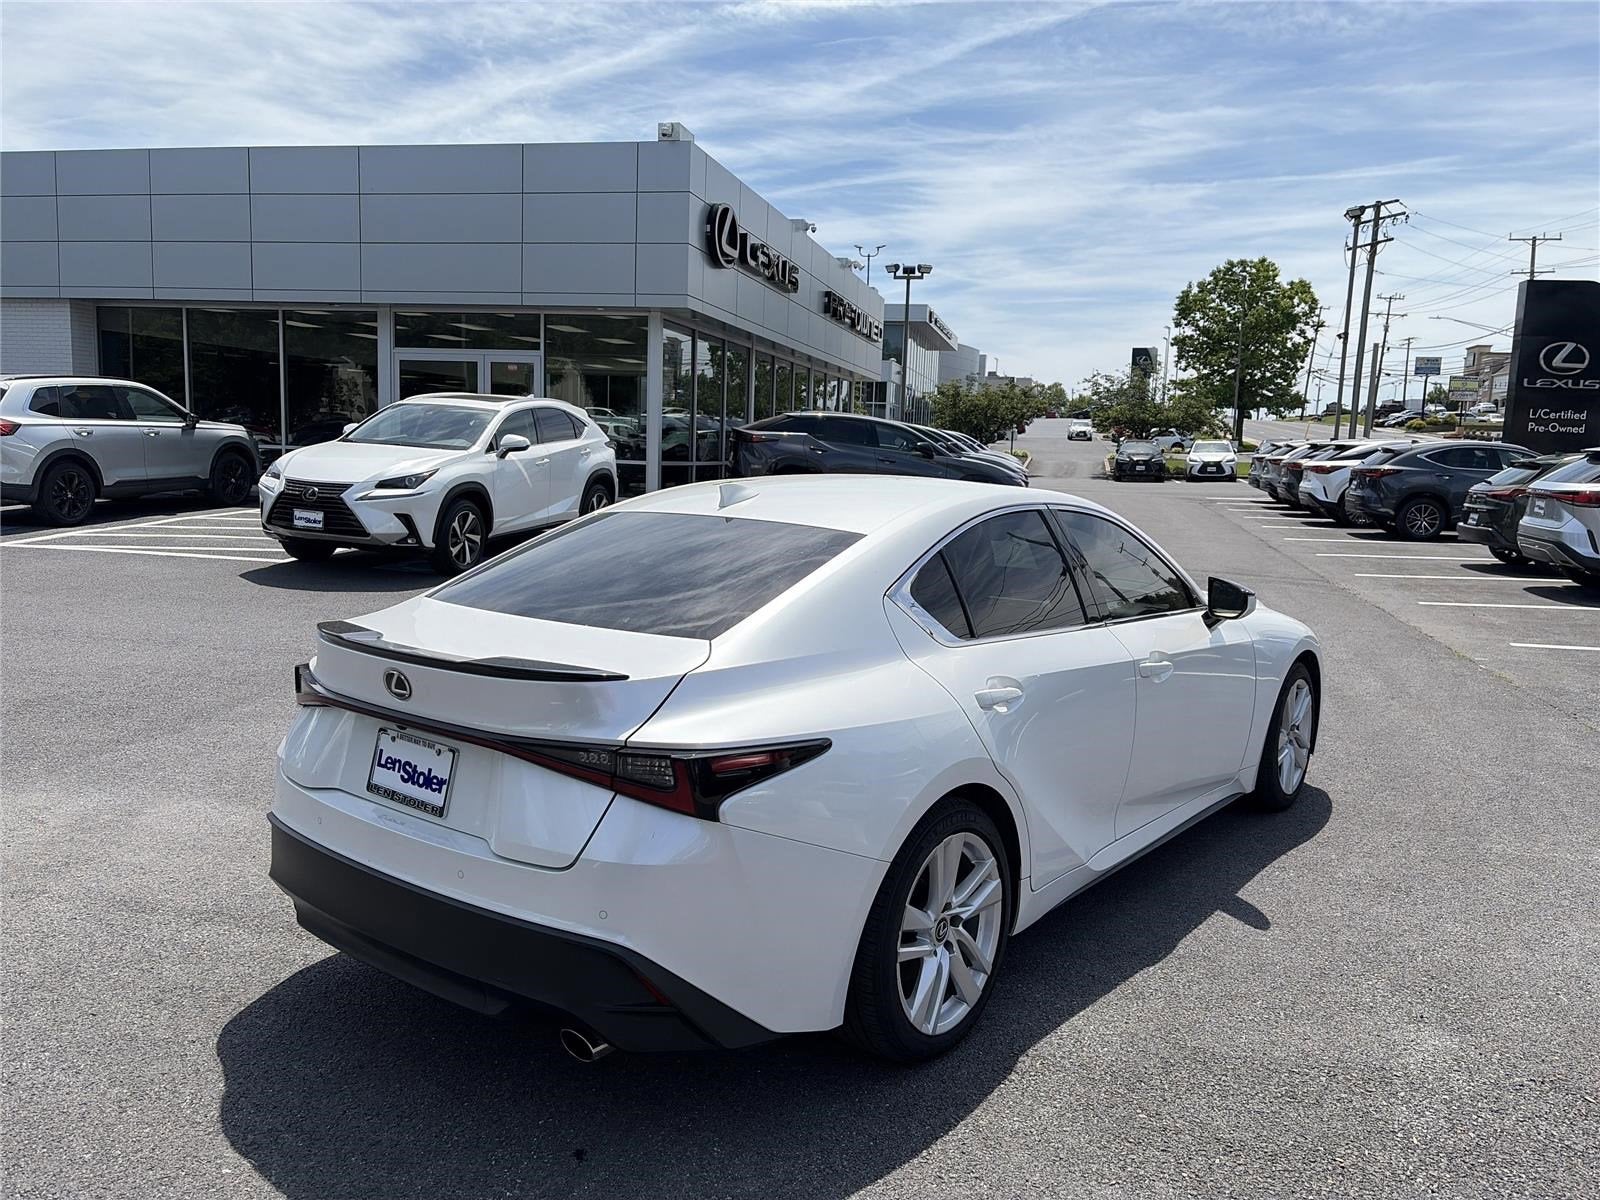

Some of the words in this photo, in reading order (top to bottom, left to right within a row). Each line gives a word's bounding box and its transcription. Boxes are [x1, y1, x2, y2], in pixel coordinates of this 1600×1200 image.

[739, 233, 799, 293] LEXUS
[1523, 378, 1600, 390] LEXUS
[1529, 408, 1587, 420] L/Certified
[1528, 422, 1586, 434] Pre-Owned
[370, 783, 392, 799] LEN
[393, 790, 440, 816] STOLER
